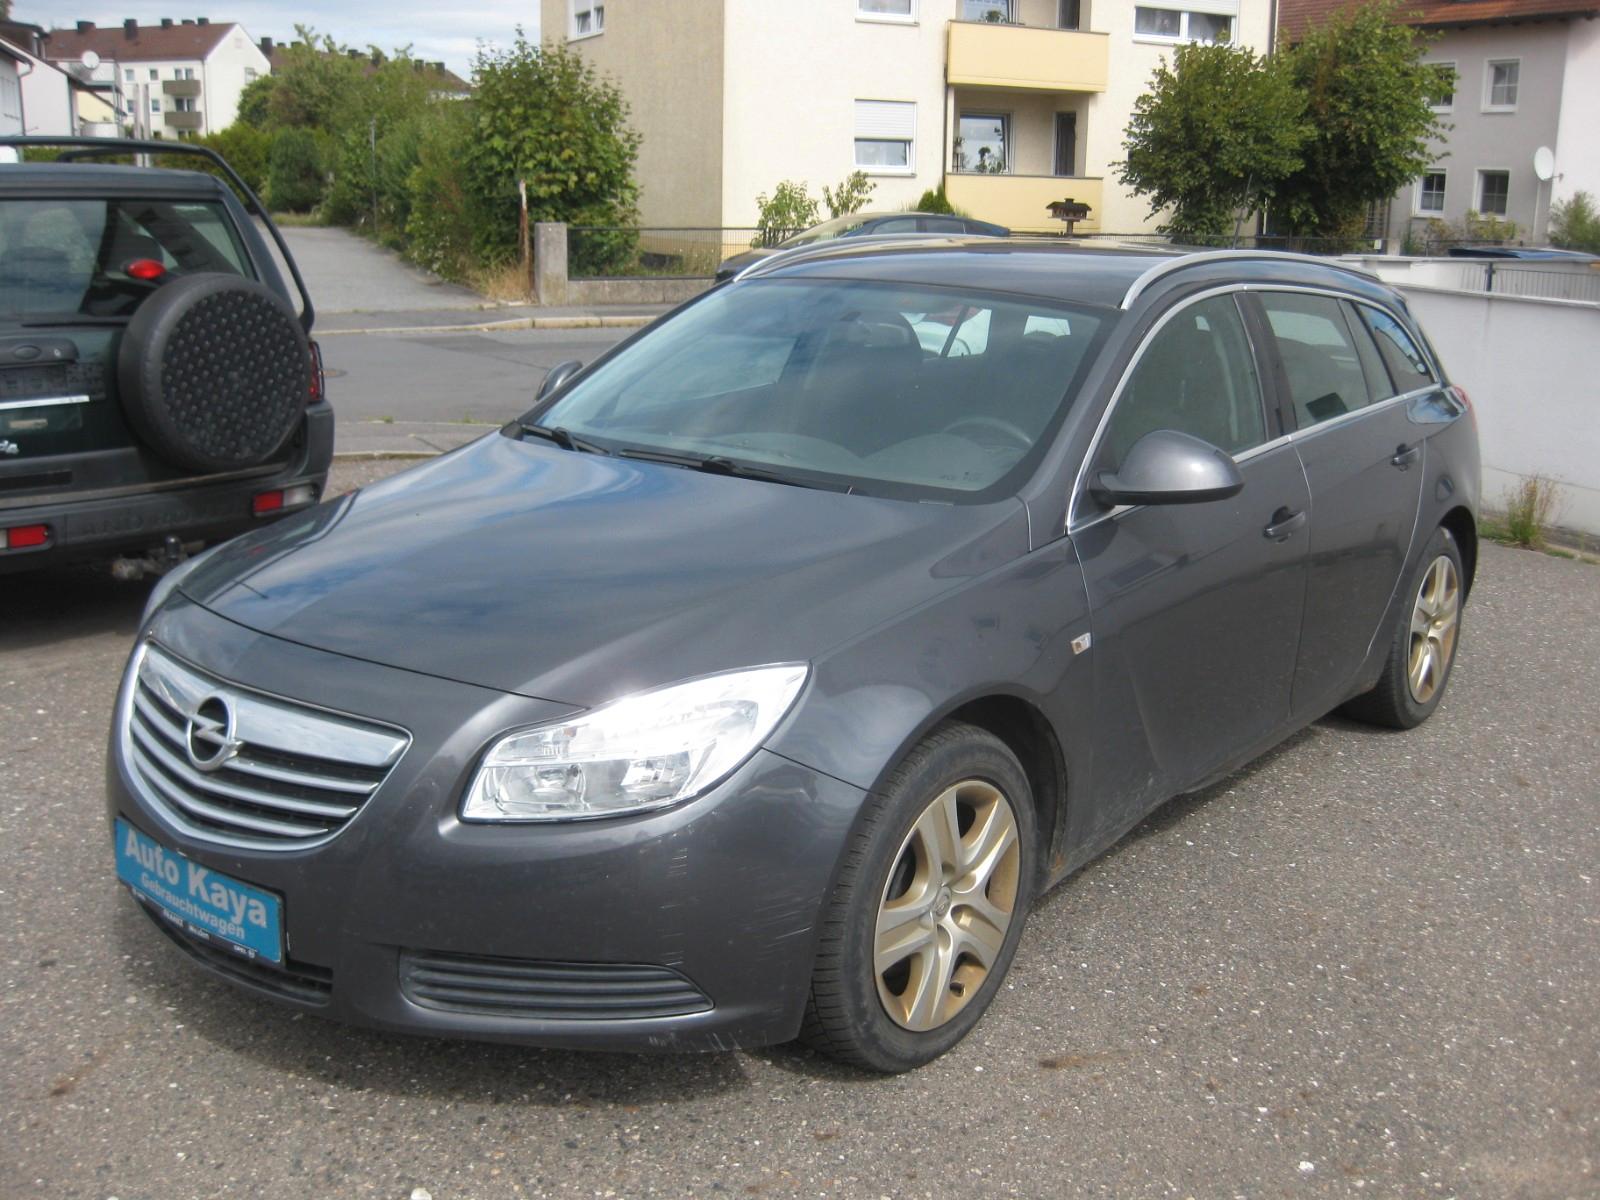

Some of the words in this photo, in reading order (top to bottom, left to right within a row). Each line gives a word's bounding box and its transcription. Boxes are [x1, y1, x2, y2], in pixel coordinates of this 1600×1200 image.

[126, 829, 179, 885] Auto
[188, 862, 267, 928] Kaya
[141, 873, 245, 939] Gebrauchtwagen
